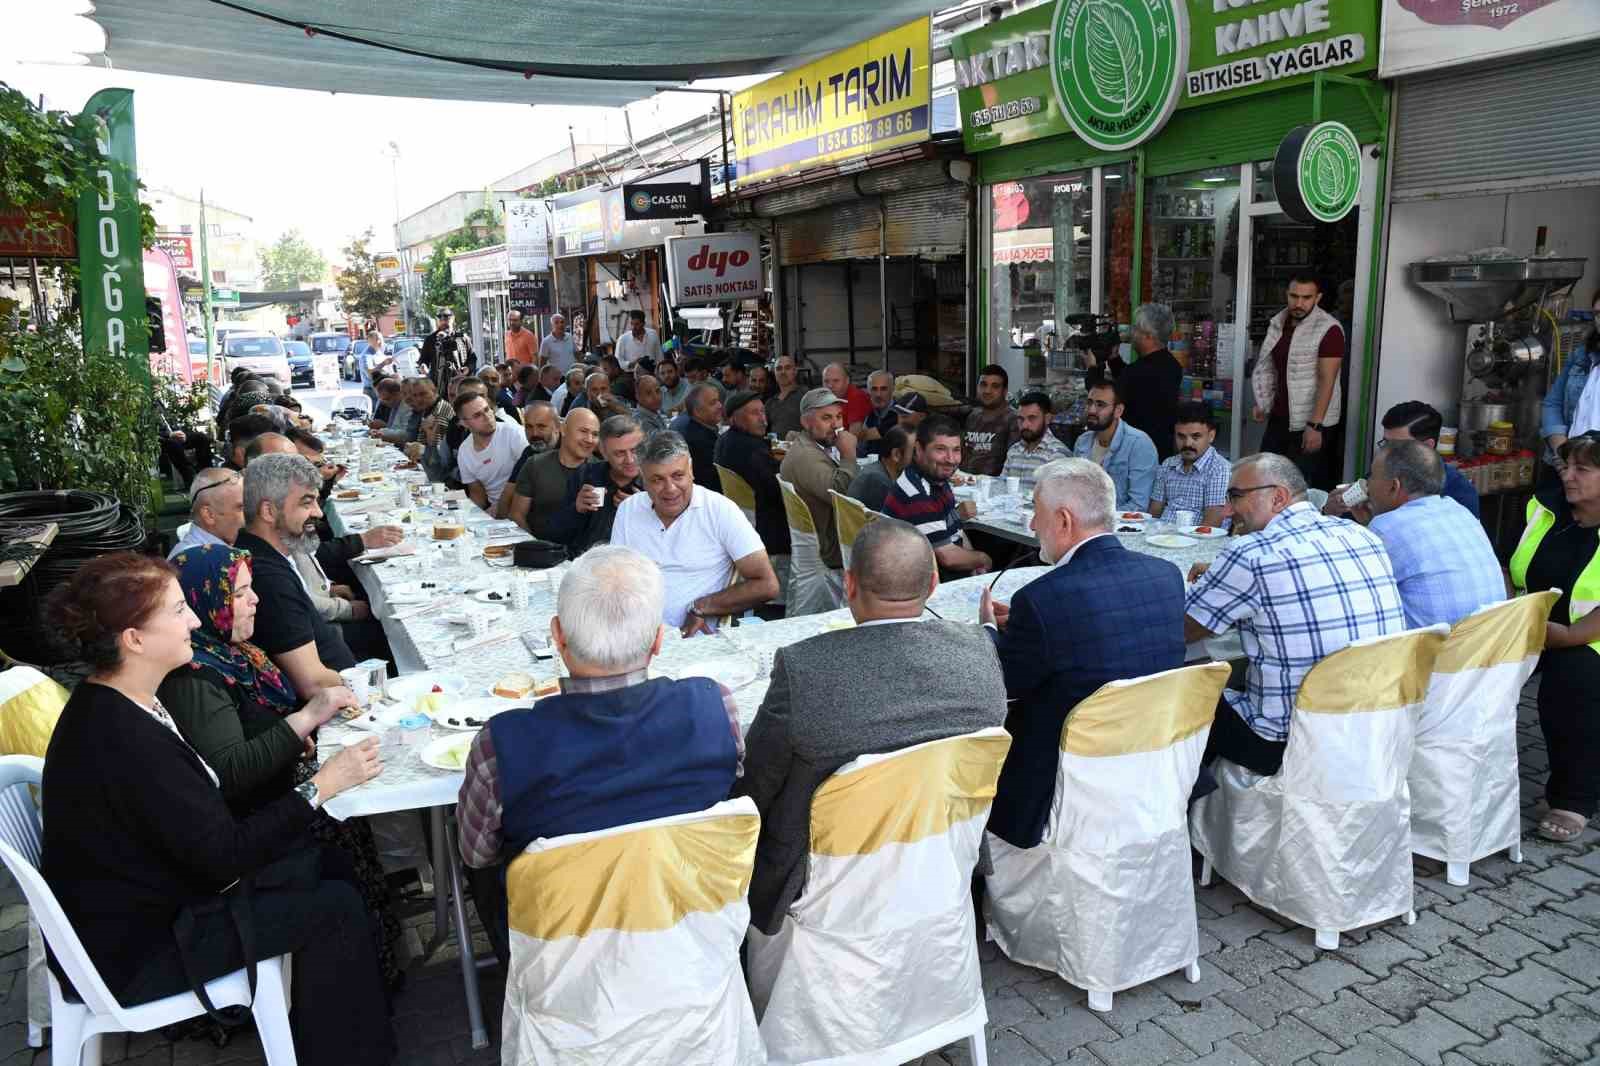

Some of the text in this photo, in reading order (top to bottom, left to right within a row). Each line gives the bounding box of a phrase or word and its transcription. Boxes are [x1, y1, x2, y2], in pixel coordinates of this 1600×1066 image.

[1216, 0, 1331, 56] KAHVE
[1490, 3, 1520, 18] 1972
[1189, 38, 1354, 95] BİTKİSEL YAĞLAR
[737, 48, 912, 147] İBRAHİM TARIM
[817, 111, 913, 154] 0 534 682 89 66
[688, 244, 750, 277] dyo
[715, 280, 758, 294] NOKTASI
